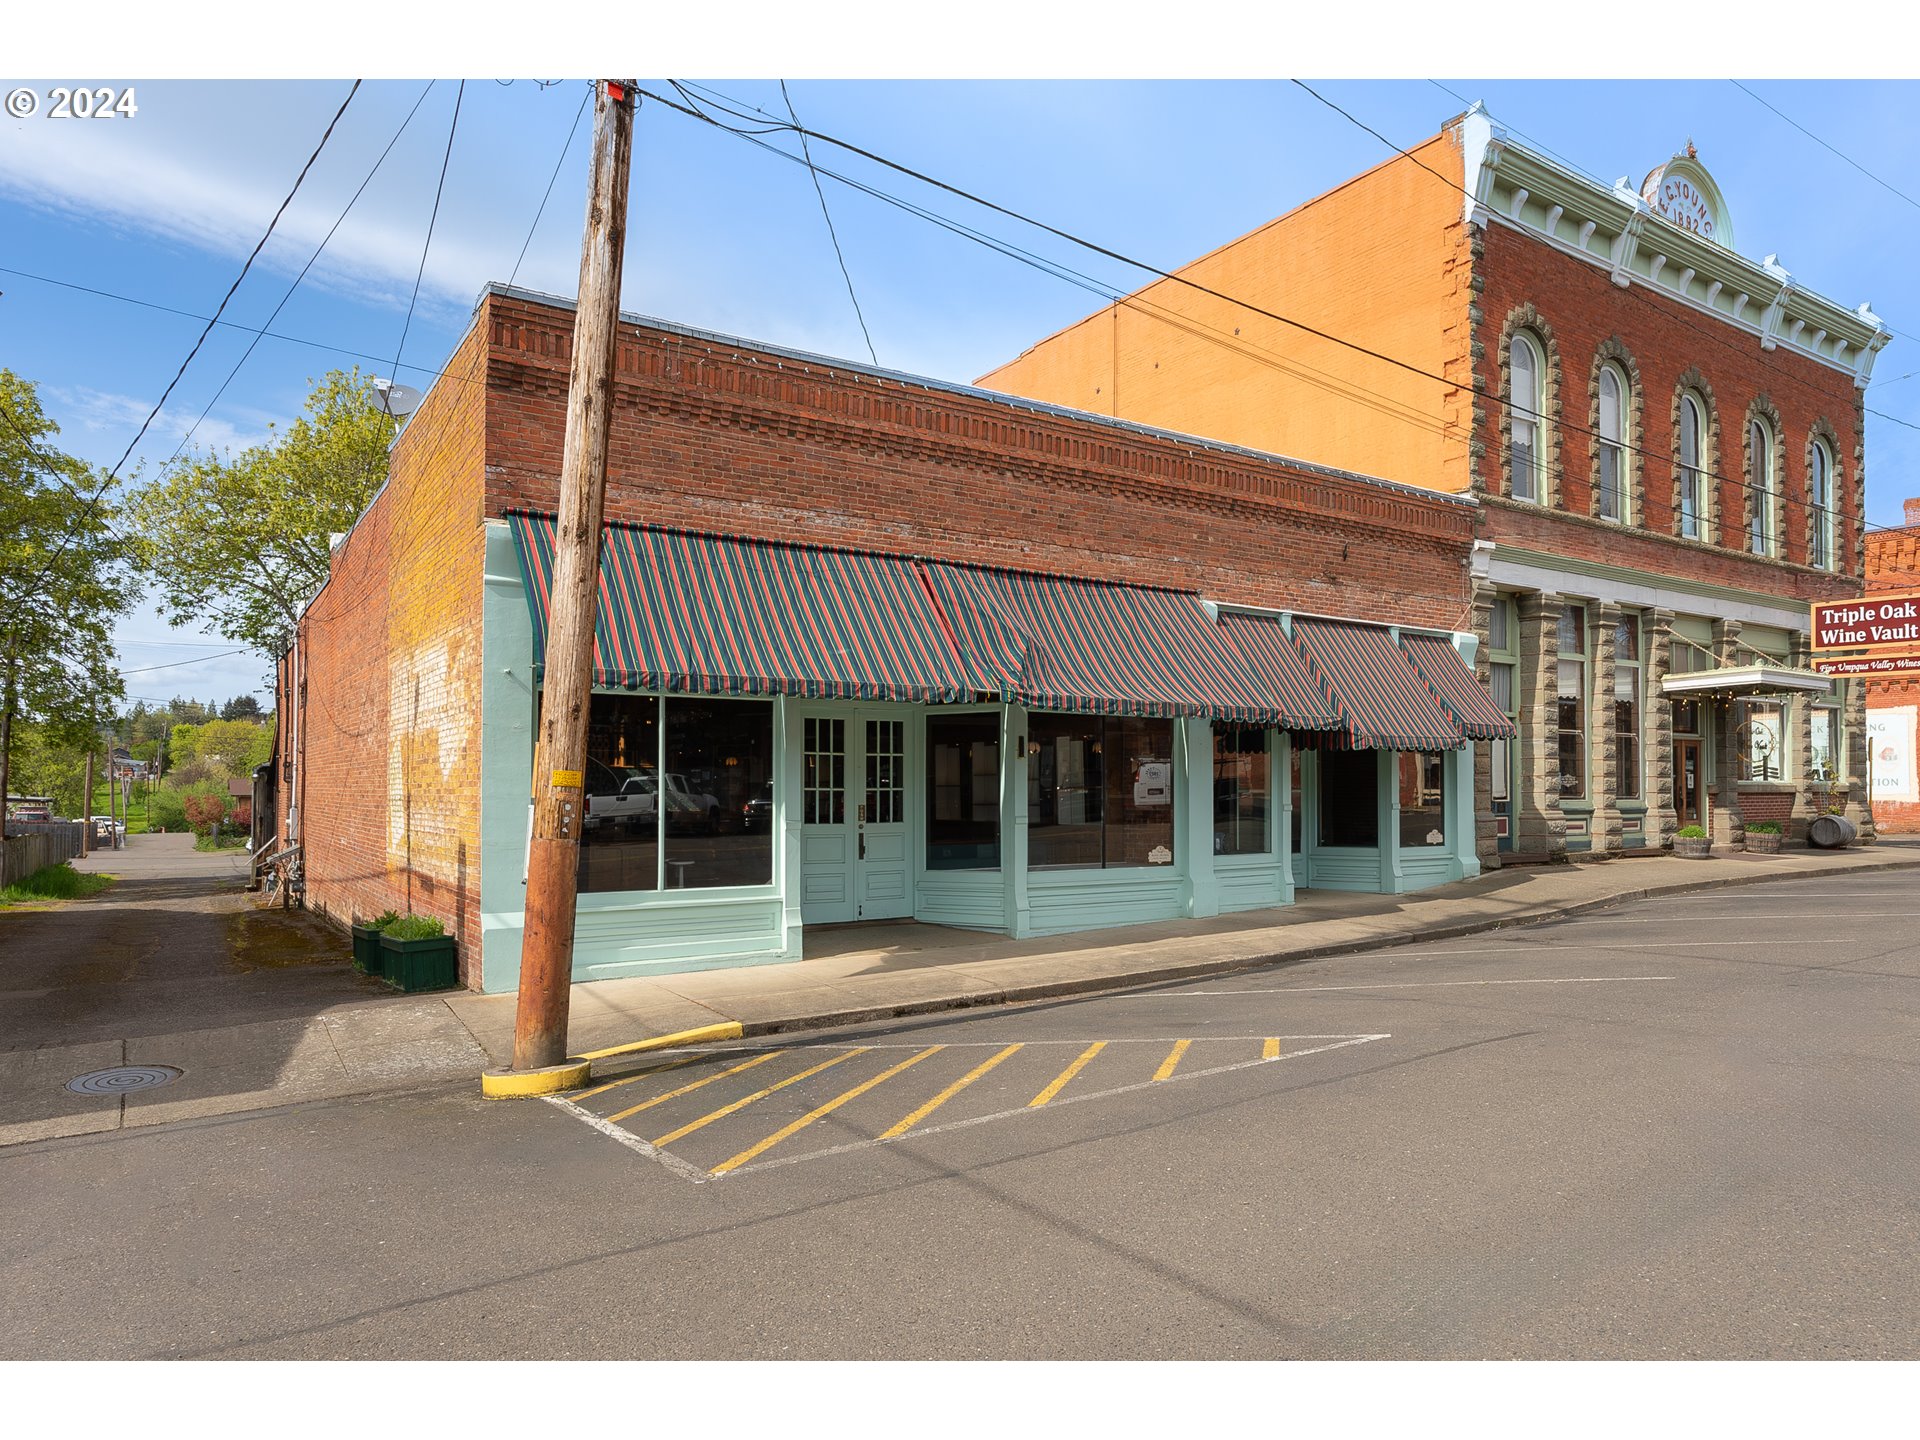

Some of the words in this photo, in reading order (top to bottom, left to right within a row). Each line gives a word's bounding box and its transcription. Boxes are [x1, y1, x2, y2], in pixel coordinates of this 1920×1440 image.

[1821, 606, 1876, 626] Triple
[1879, 602, 1918, 619] Oak
[1820, 629, 1867, 645] Wine
[1870, 623, 1919, 641] Vault
[1838, 662, 1869, 673] Umpqua
[1870, 660, 1895, 670] Valley
[1869, 723, 1886, 732] NG
